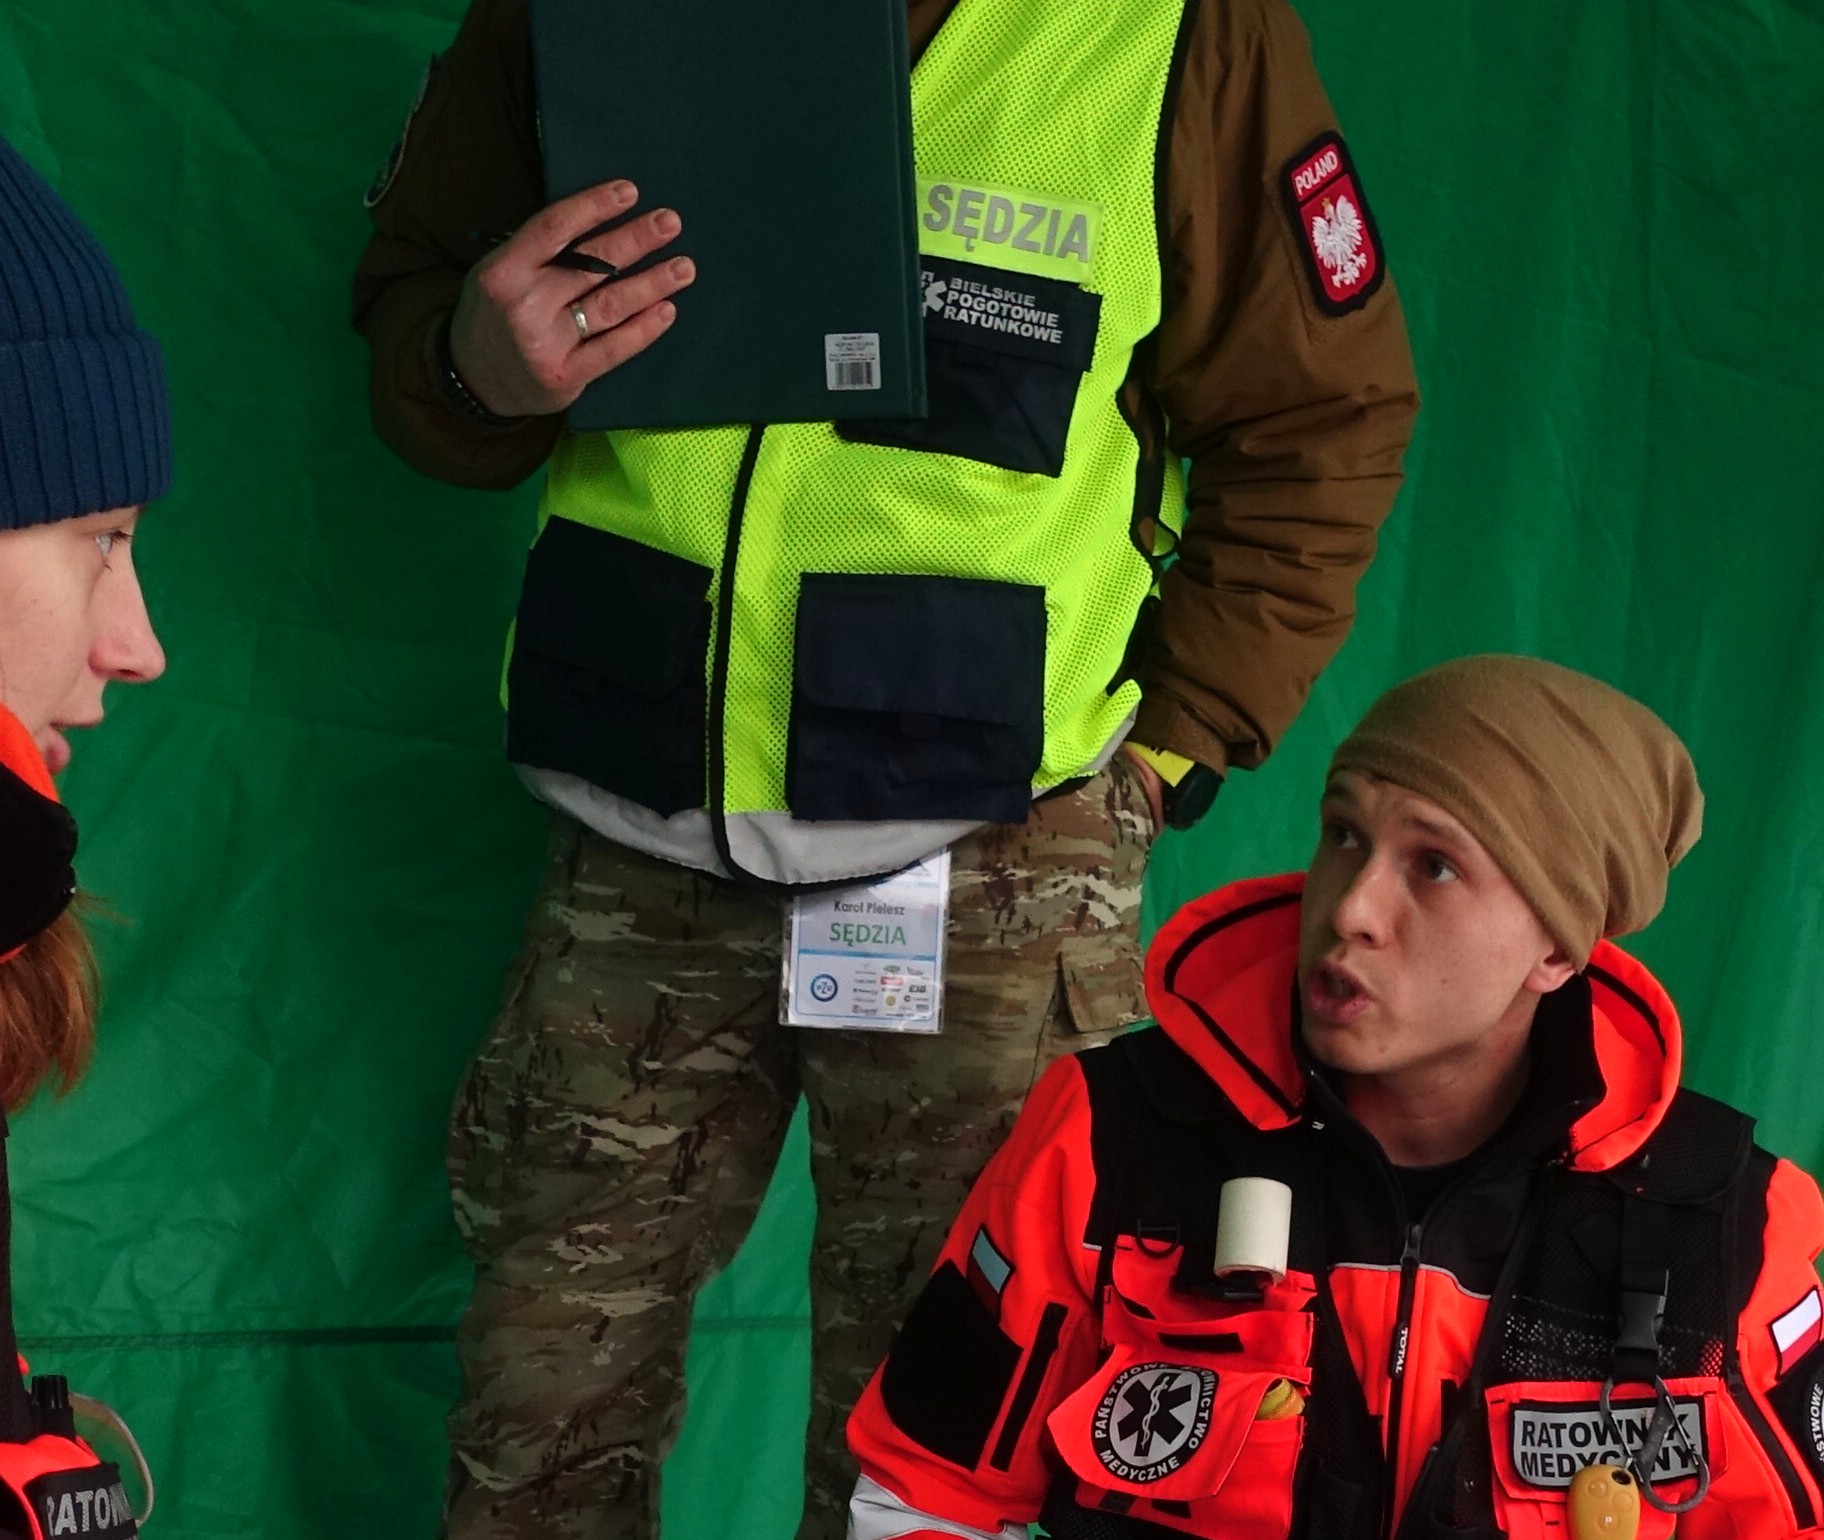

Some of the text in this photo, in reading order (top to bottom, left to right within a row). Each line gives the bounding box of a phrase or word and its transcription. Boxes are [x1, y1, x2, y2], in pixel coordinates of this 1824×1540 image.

[1294, 150, 1339, 196] POLAND
[922, 183, 1090, 264] SĘDZIA
[946, 290, 1060, 328] POGOTOWIE
[949, 277, 1036, 307] BIELSKIE
[943, 305, 1063, 344] RATUNKOWE
[829, 921, 907, 948] SĘDZIA
[1395, 1327, 1409, 1374] TOTAL
[1521, 1413, 1692, 1449] RATOWNK
[1099, 1449, 1180, 1482] MEDYCZNE
